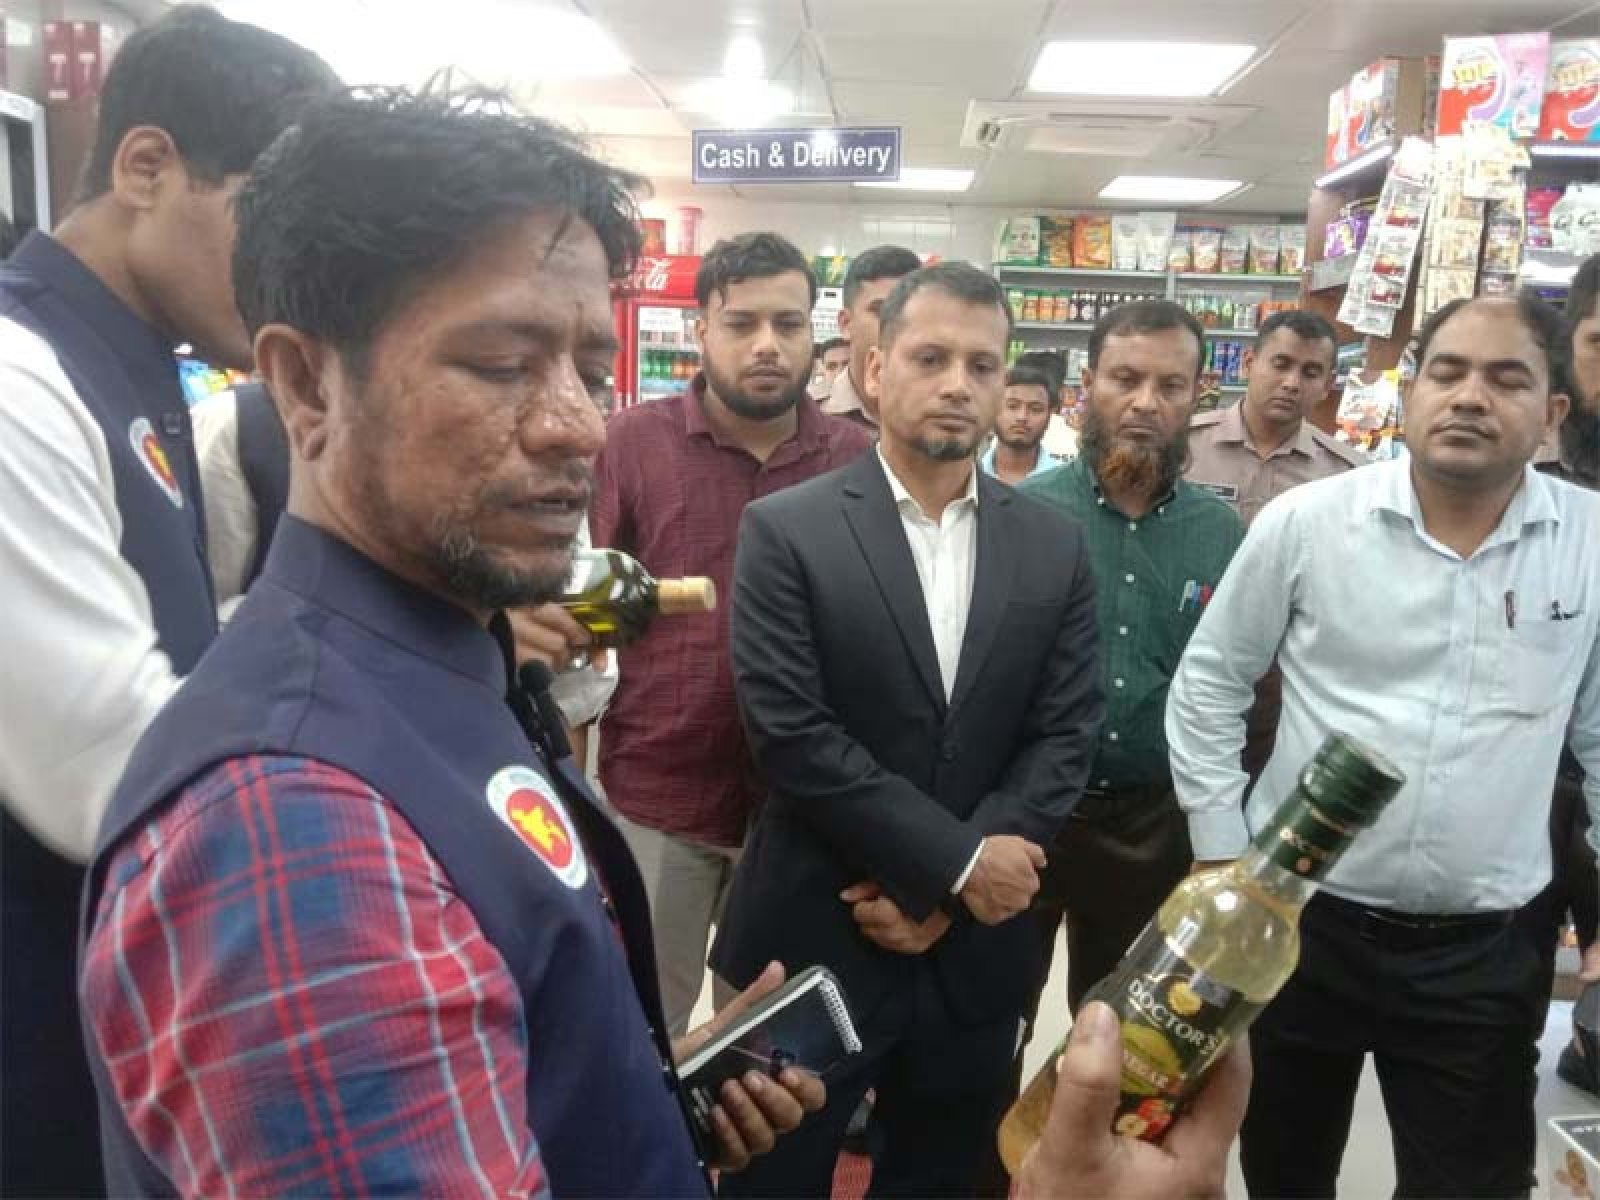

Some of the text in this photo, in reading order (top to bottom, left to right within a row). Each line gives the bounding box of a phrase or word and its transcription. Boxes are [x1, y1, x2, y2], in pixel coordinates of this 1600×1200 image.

[701, 141, 892, 173] Cash & Delivery
